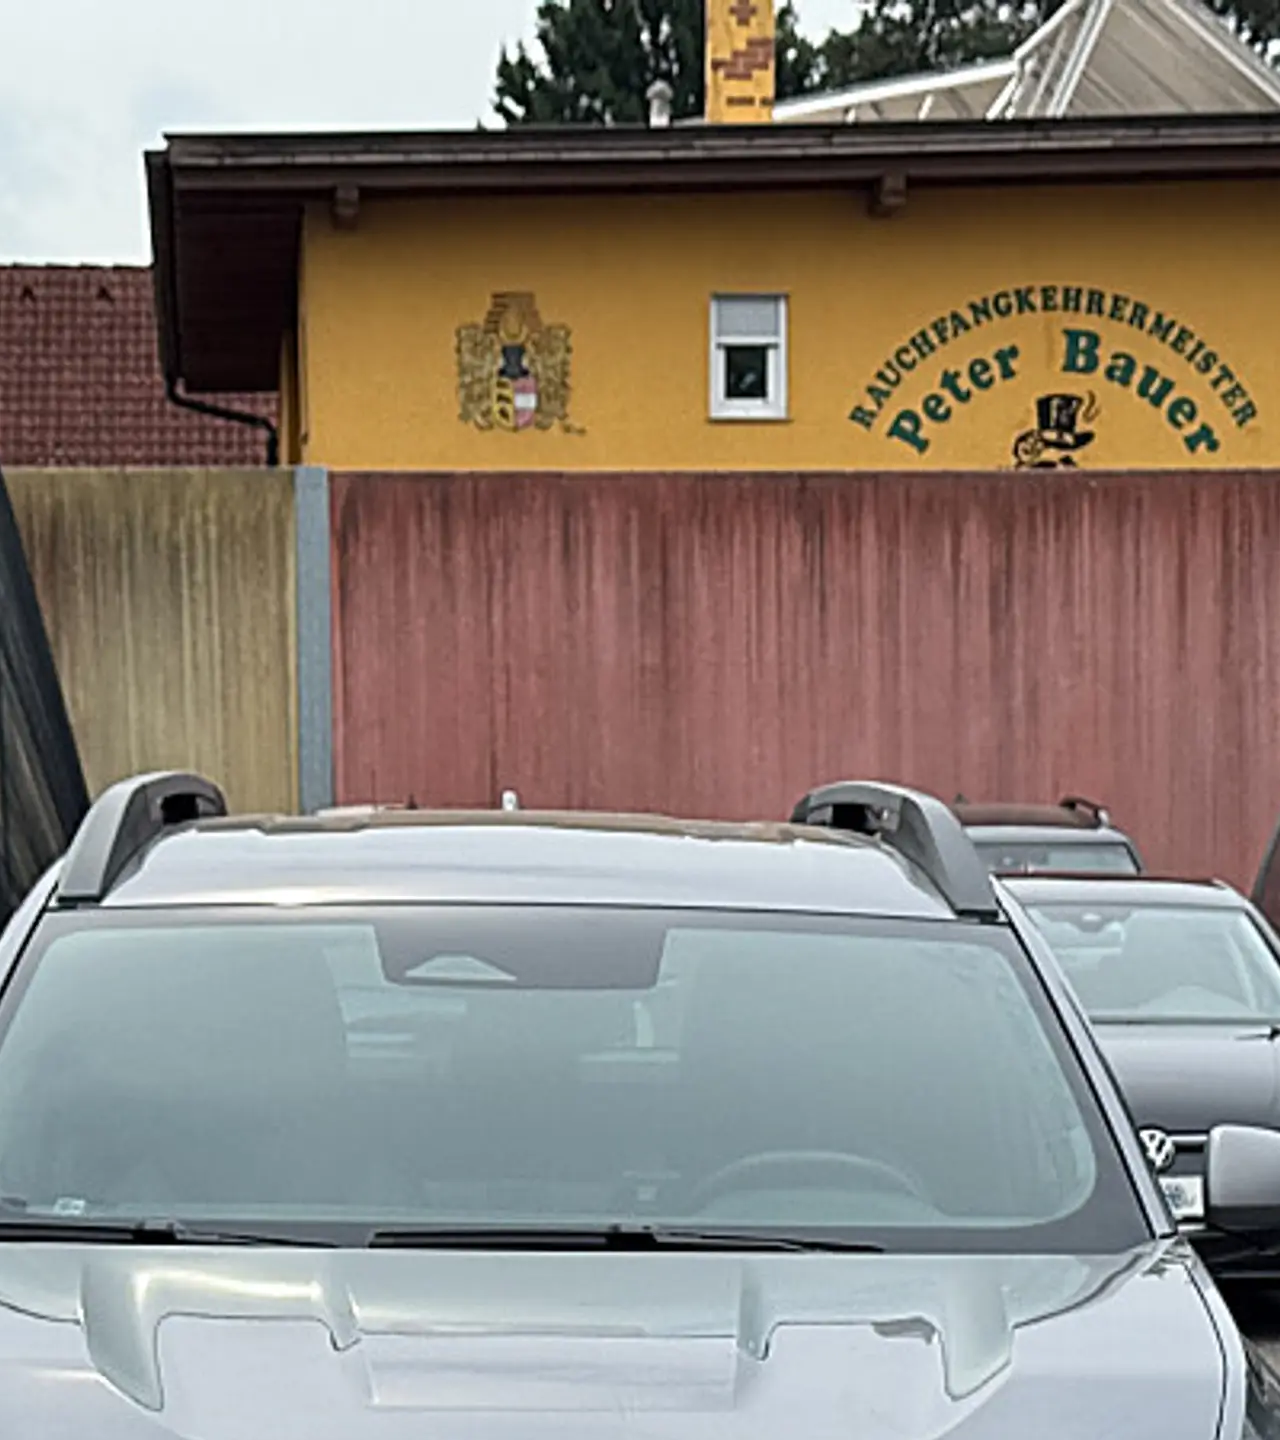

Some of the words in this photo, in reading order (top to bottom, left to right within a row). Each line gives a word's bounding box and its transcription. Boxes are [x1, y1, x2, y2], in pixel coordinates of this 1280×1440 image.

[848, 285, 1258, 431] RAUCHFANGKEHRERMEISTER
[886, 343, 1020, 454] Peter
[1061, 328, 1220, 454] Bauer
